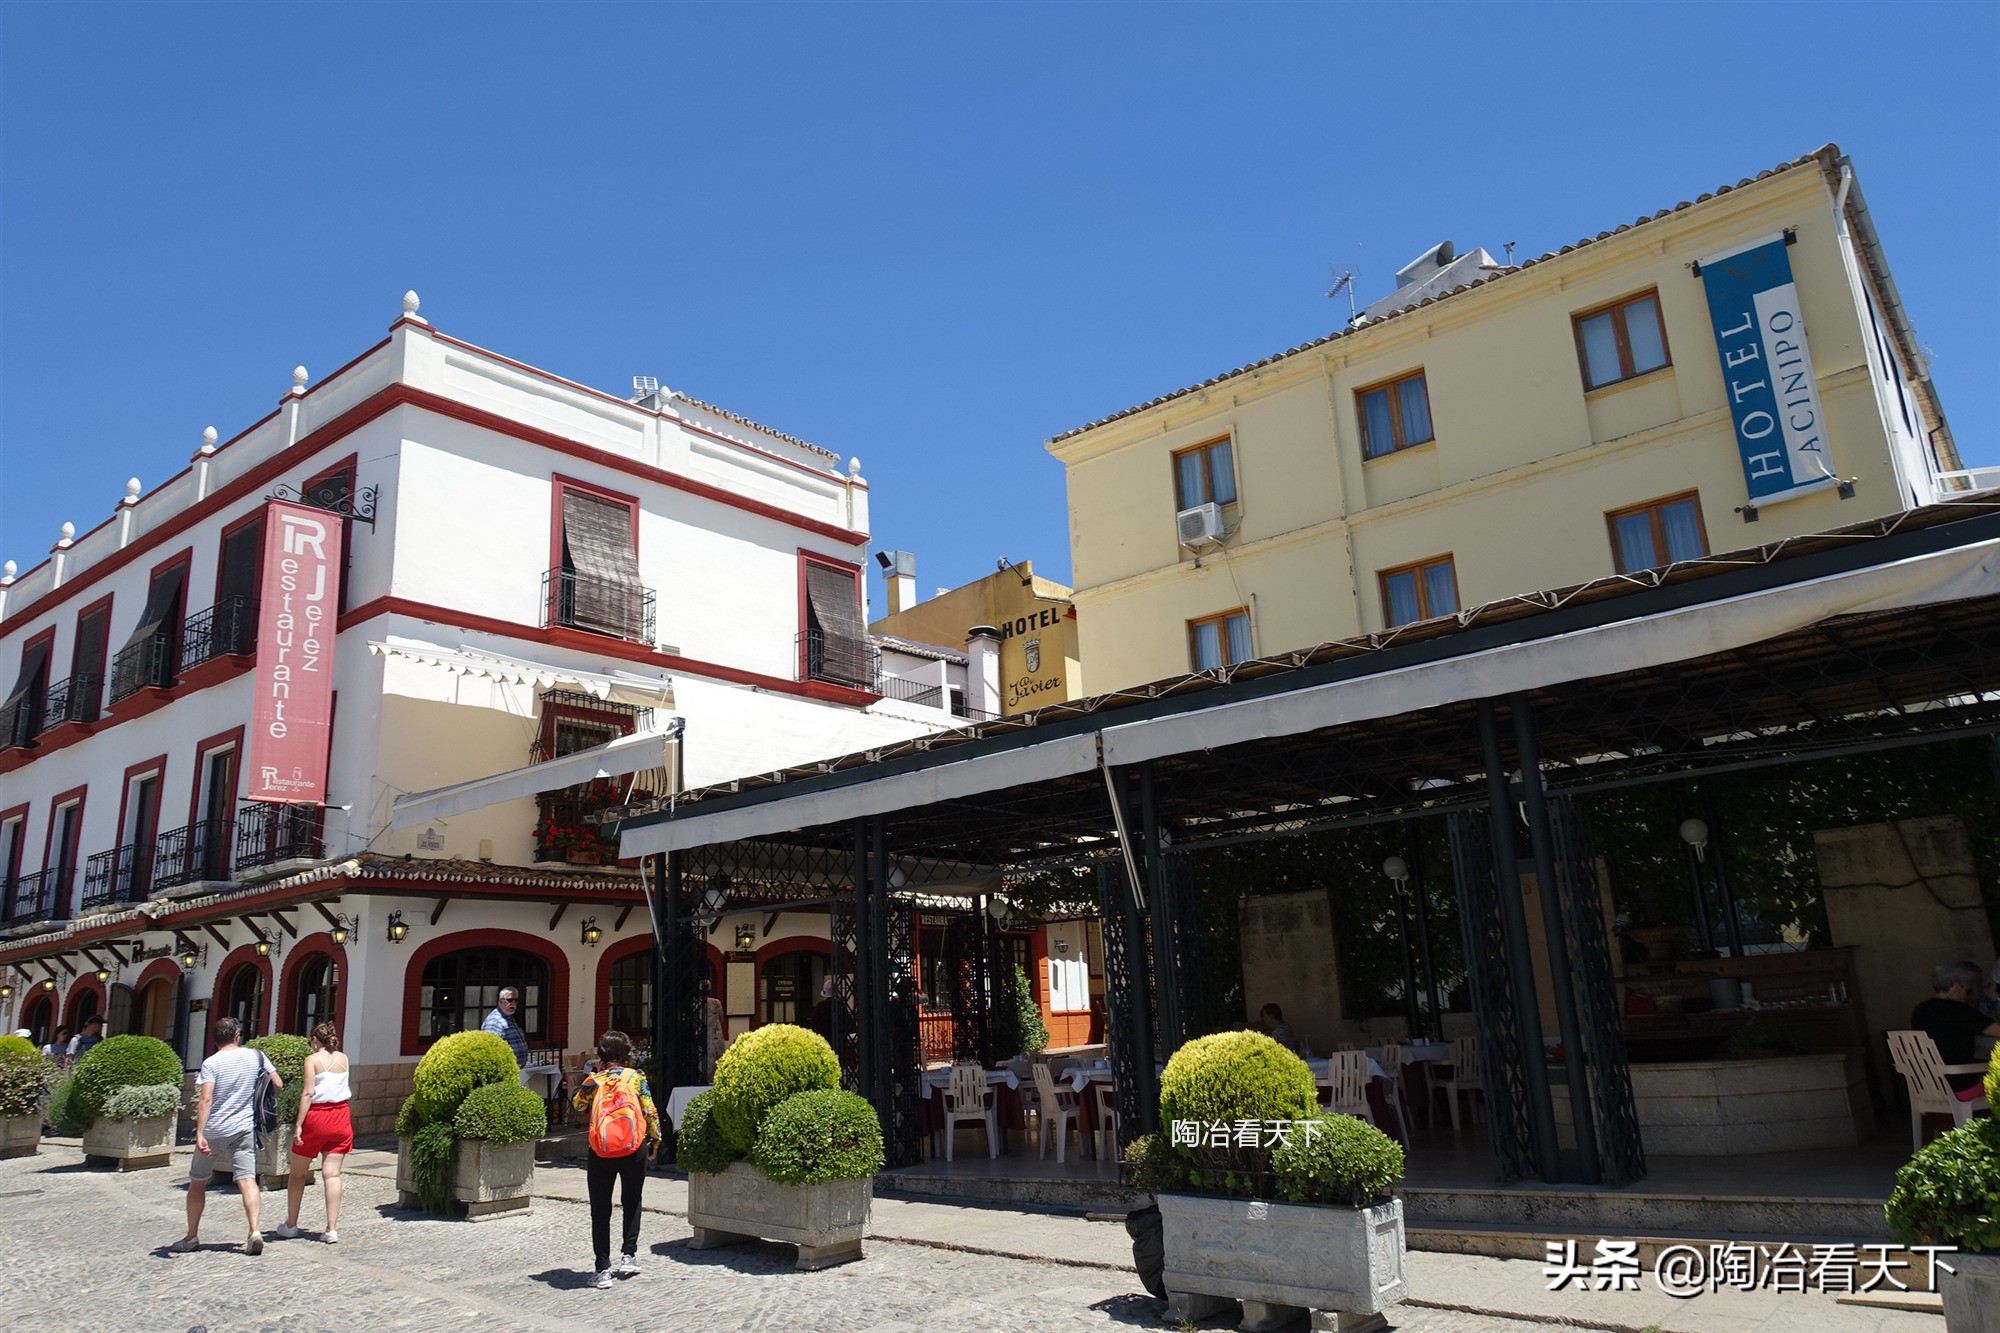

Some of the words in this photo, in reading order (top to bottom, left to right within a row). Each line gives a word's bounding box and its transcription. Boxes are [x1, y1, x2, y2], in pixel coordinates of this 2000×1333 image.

[1721, 312, 1784, 480] HOTEL
[1769, 311, 1820, 453] ACINIPO
[269, 514, 327, 739] Restaurante
[302, 564, 326, 673] Jerez
[1002, 607, 1060, 640] HOTEL
[1008, 676, 1062, 707] Javier
[261, 766, 315, 788] Restaurante
[262, 779, 288, 791] Jerez
